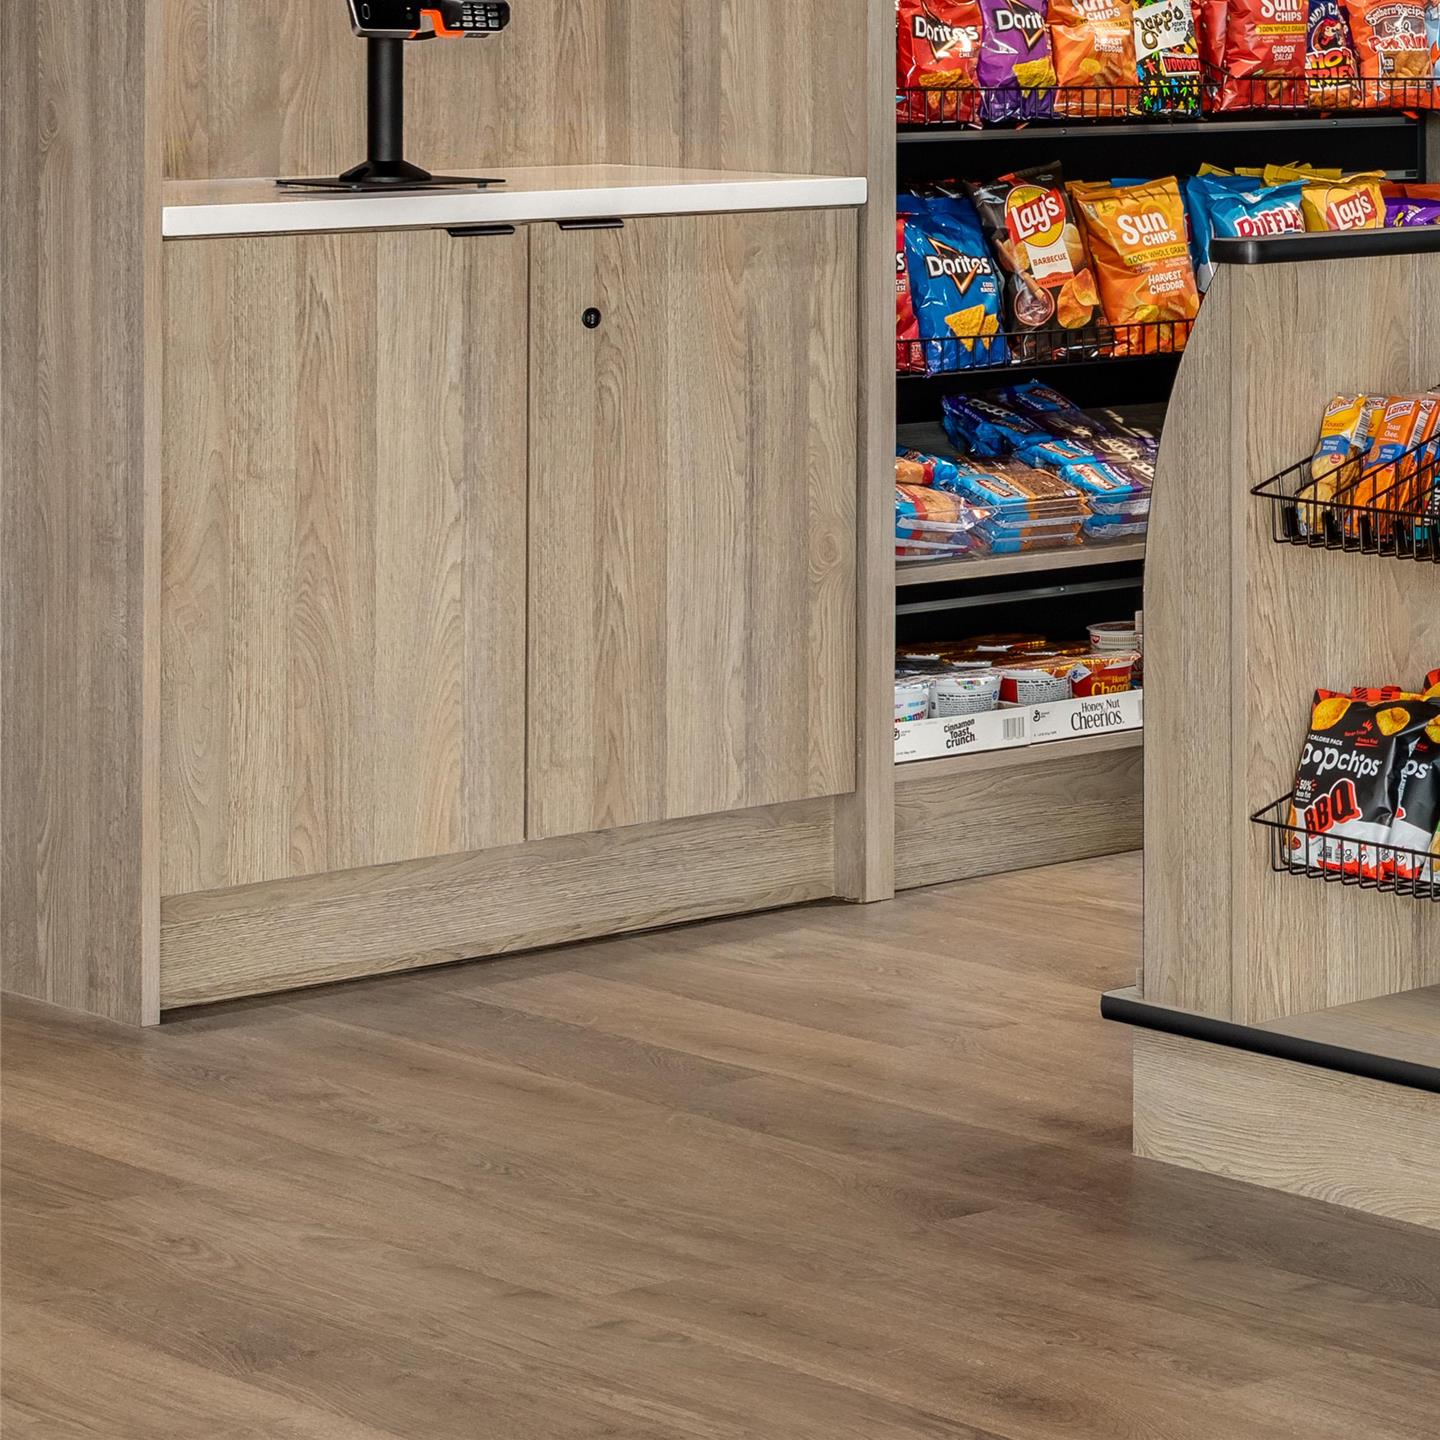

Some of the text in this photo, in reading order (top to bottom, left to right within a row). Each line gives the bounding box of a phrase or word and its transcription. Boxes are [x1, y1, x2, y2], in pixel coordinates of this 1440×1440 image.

[1086, 8, 1120, 21] CHIPS
[1275, 11, 1301, 21] CHIPS
[1272, 45, 1295, 53] GARDEN
[1273, 53, 1292, 61] SALSA
[1010, 194, 1061, 239] Lay's
[1334, 192, 1373, 230] Lay's
[1116, 211, 1168, 245] Sun
[1142, 230, 1176, 247] CHIPS
[1033, 253, 1068, 266] BARBECUE
[1127, 254, 1146, 264] 100%
[1147, 249, 1168, 260] WHOLE
[926, 255, 991, 277] Doritos
[1147, 270, 1182, 285] HARVEST
[1150, 281, 1185, 296] CHEDDAR
[1082, 699, 1120, 713] Honey Nut
[944, 719, 975, 732] Cinnamon
[1071, 711, 1122, 730] Cheerios
[946, 733, 975, 748] Crunch
[950, 727, 970, 739] Toast
[1298, 742, 1382, 779] popchips
[1303, 779, 1362, 837] BBQ
